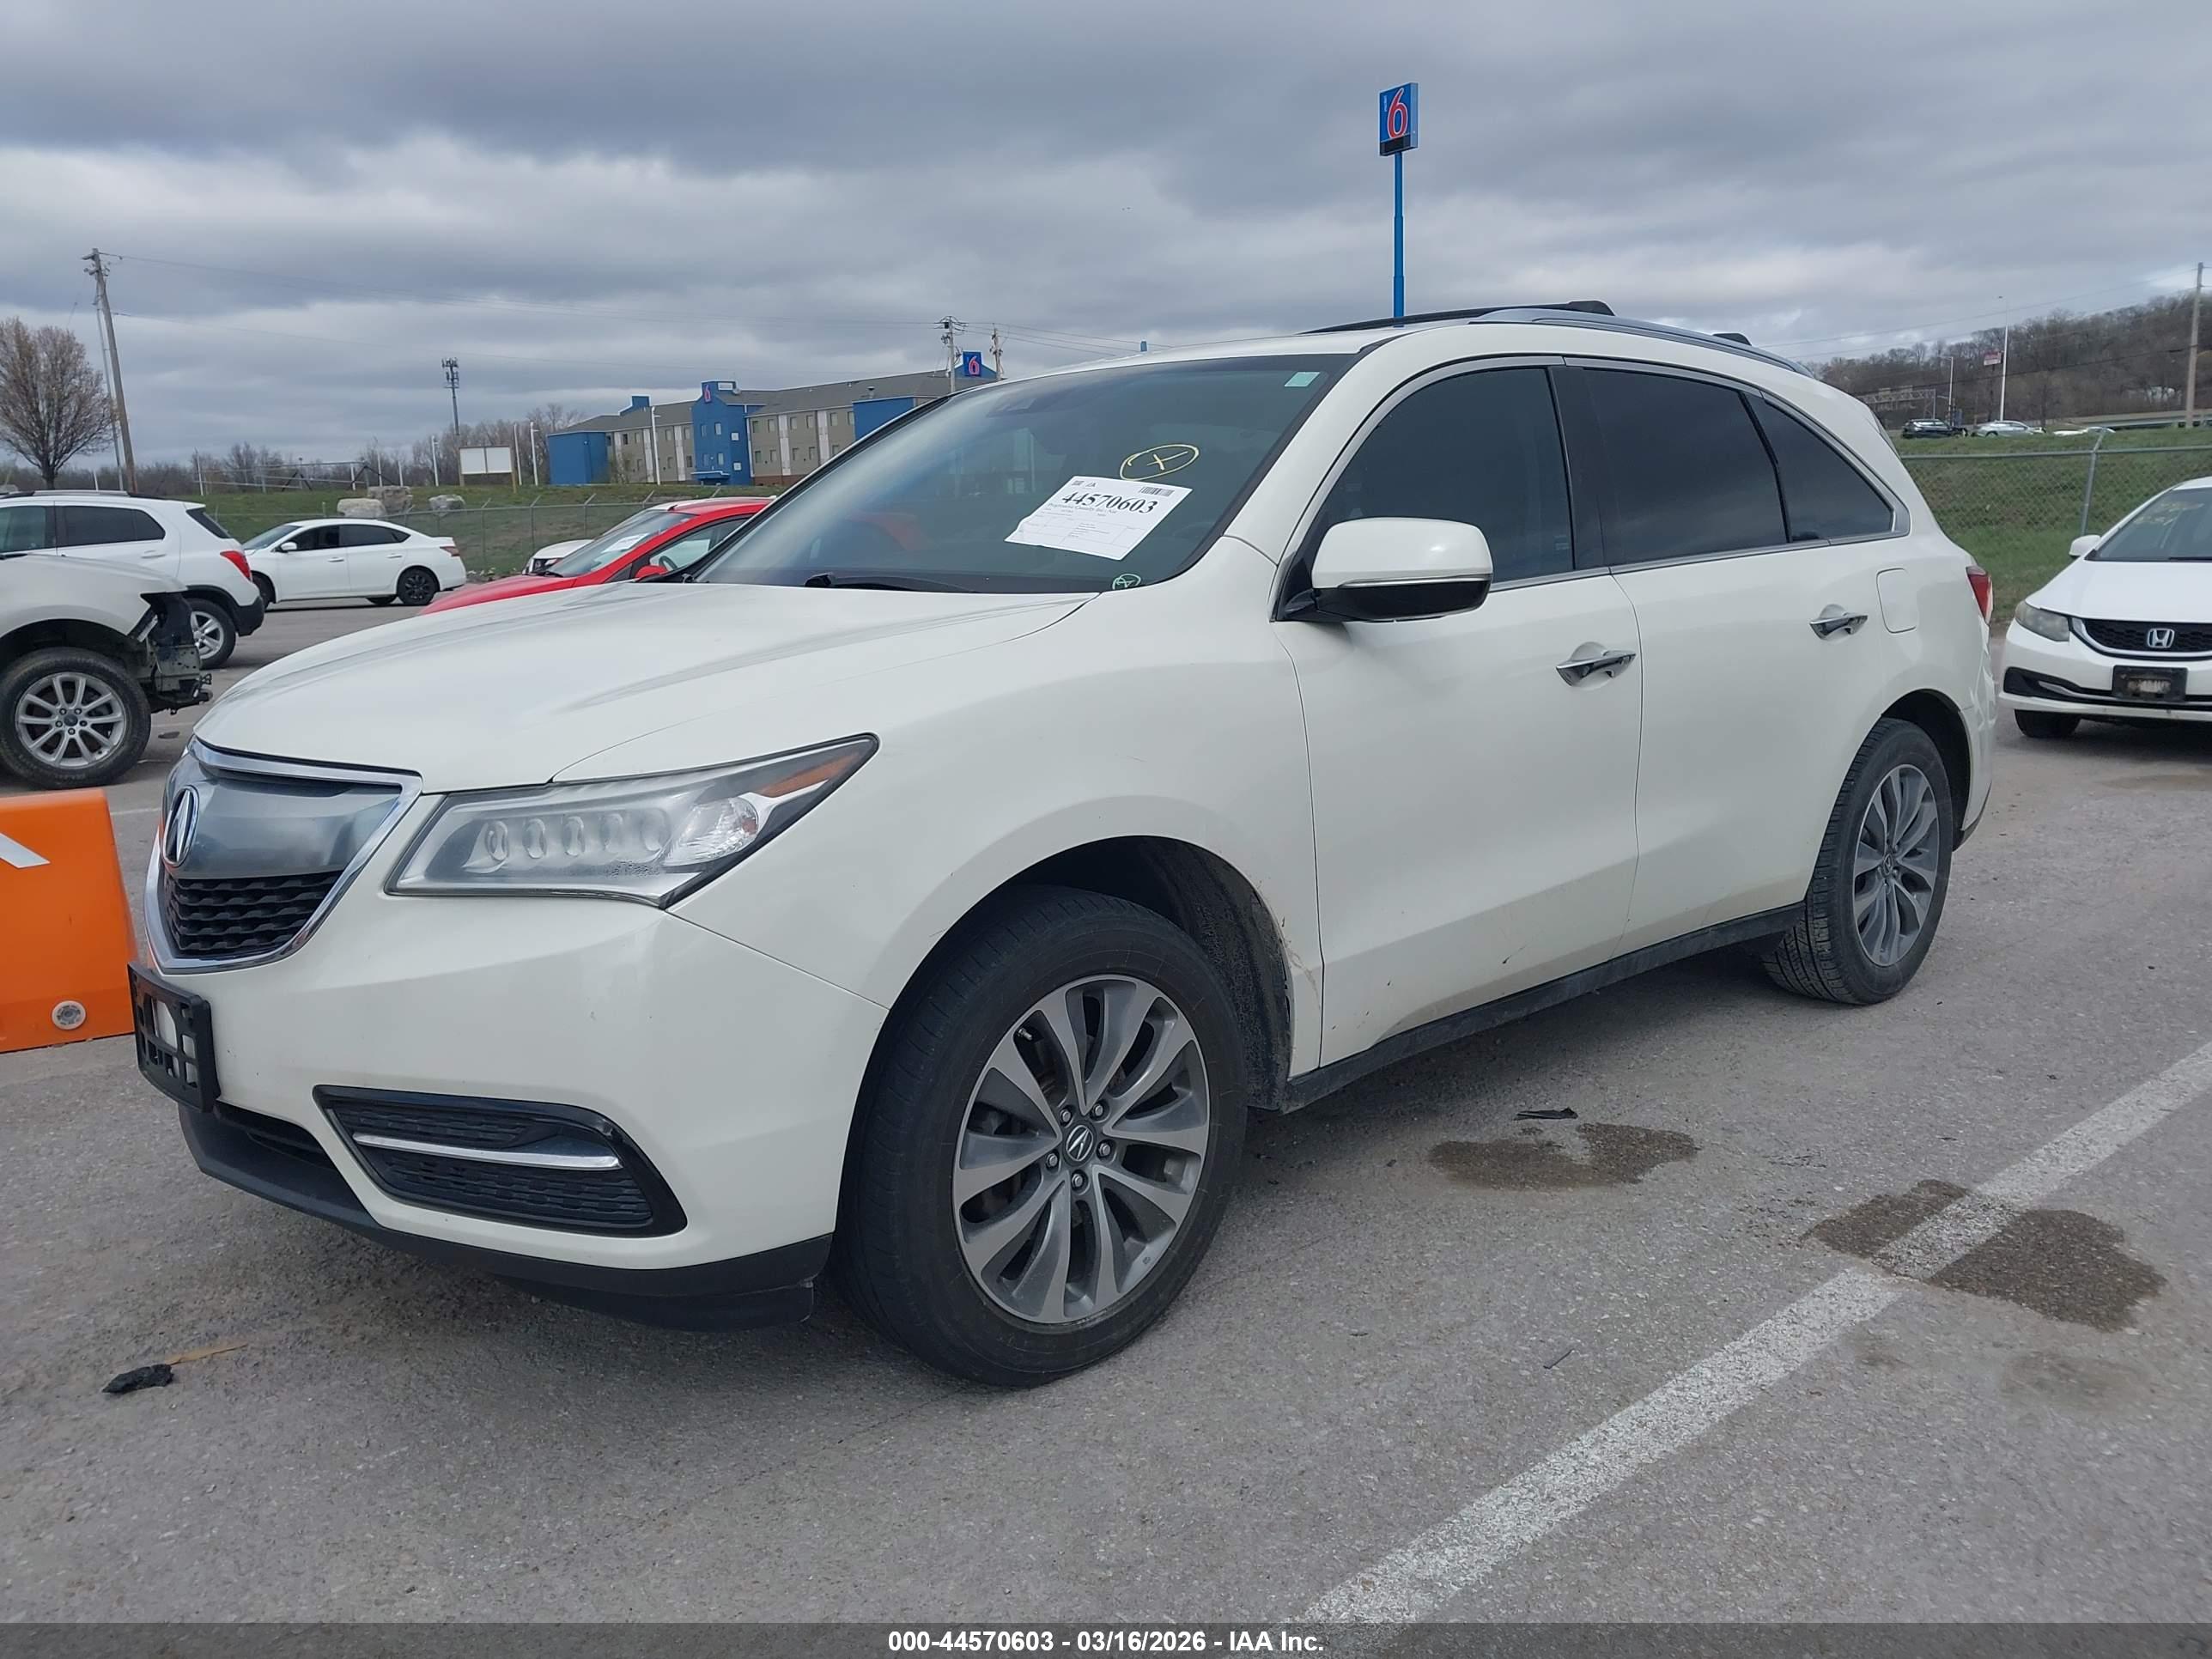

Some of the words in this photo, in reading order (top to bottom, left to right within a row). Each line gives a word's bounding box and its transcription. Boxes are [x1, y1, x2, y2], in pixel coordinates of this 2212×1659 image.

[1387, 88, 1408, 138] 6
[968, 356, 980, 375] 6
[1062, 491, 1158, 514] 44570603
